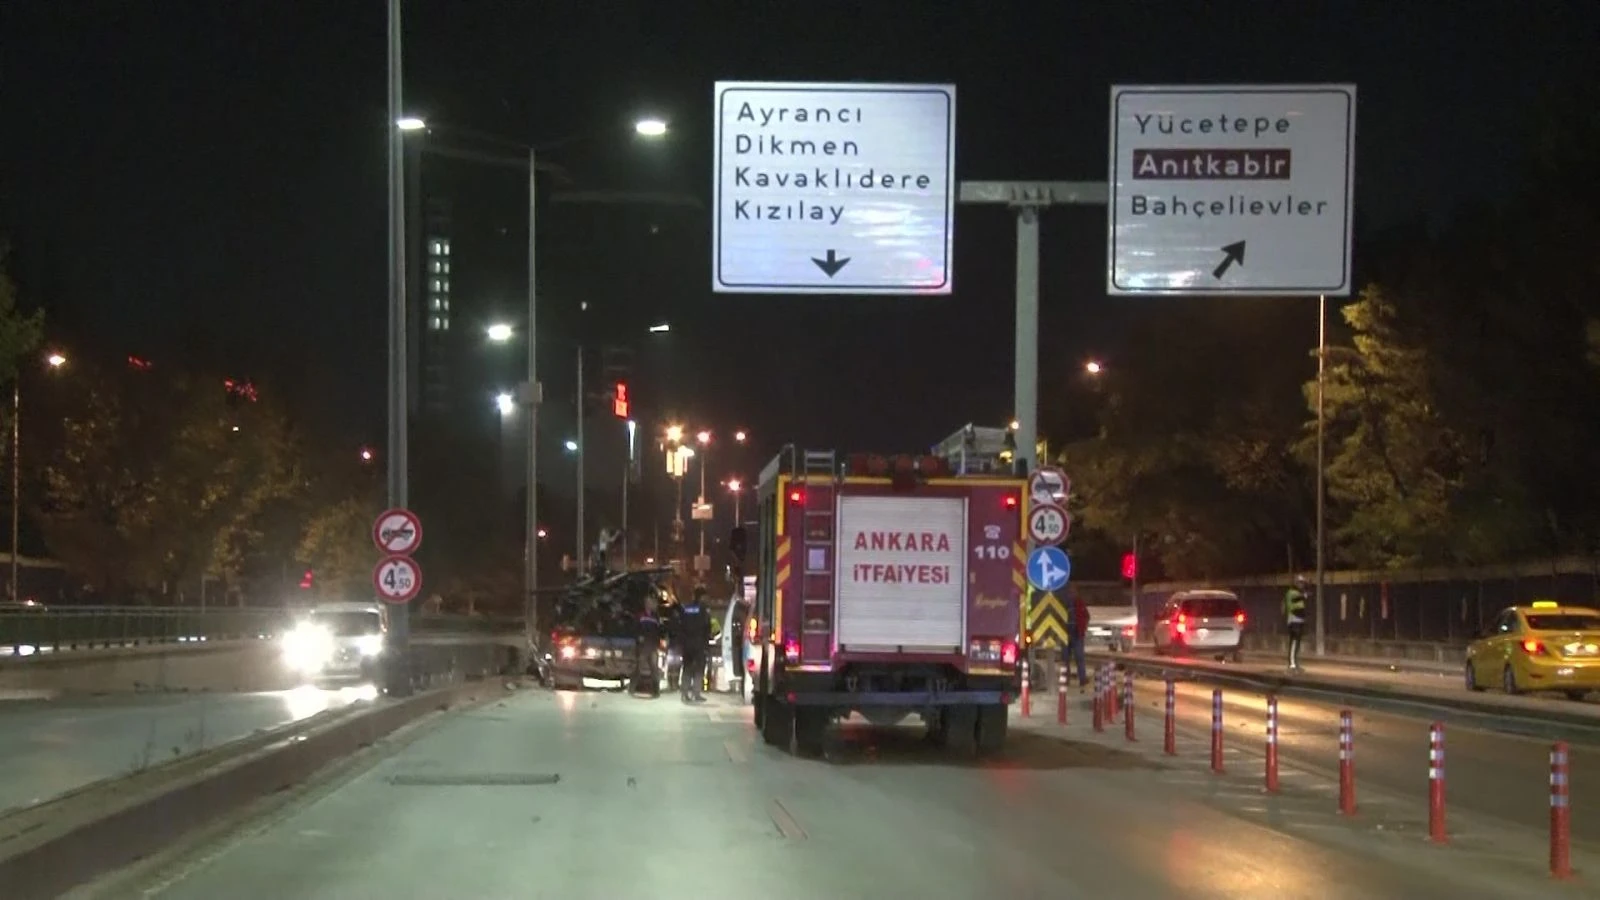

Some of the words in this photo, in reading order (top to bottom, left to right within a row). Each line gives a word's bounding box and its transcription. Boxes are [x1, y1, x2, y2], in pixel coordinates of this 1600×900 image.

[736, 101, 862, 126] Ayrancı
[1134, 113, 1291, 138] Yücetepe
[735, 134, 859, 156] Dikmen
[1138, 153, 1287, 176] Anıtkabir
[734, 166, 931, 189] Kavaklıdere
[734, 200, 845, 225] Kızılay
[1131, 195, 1328, 219] Bahçelievler
[854, 531, 950, 552] ANKARA
[974, 544, 1010, 560] 110
